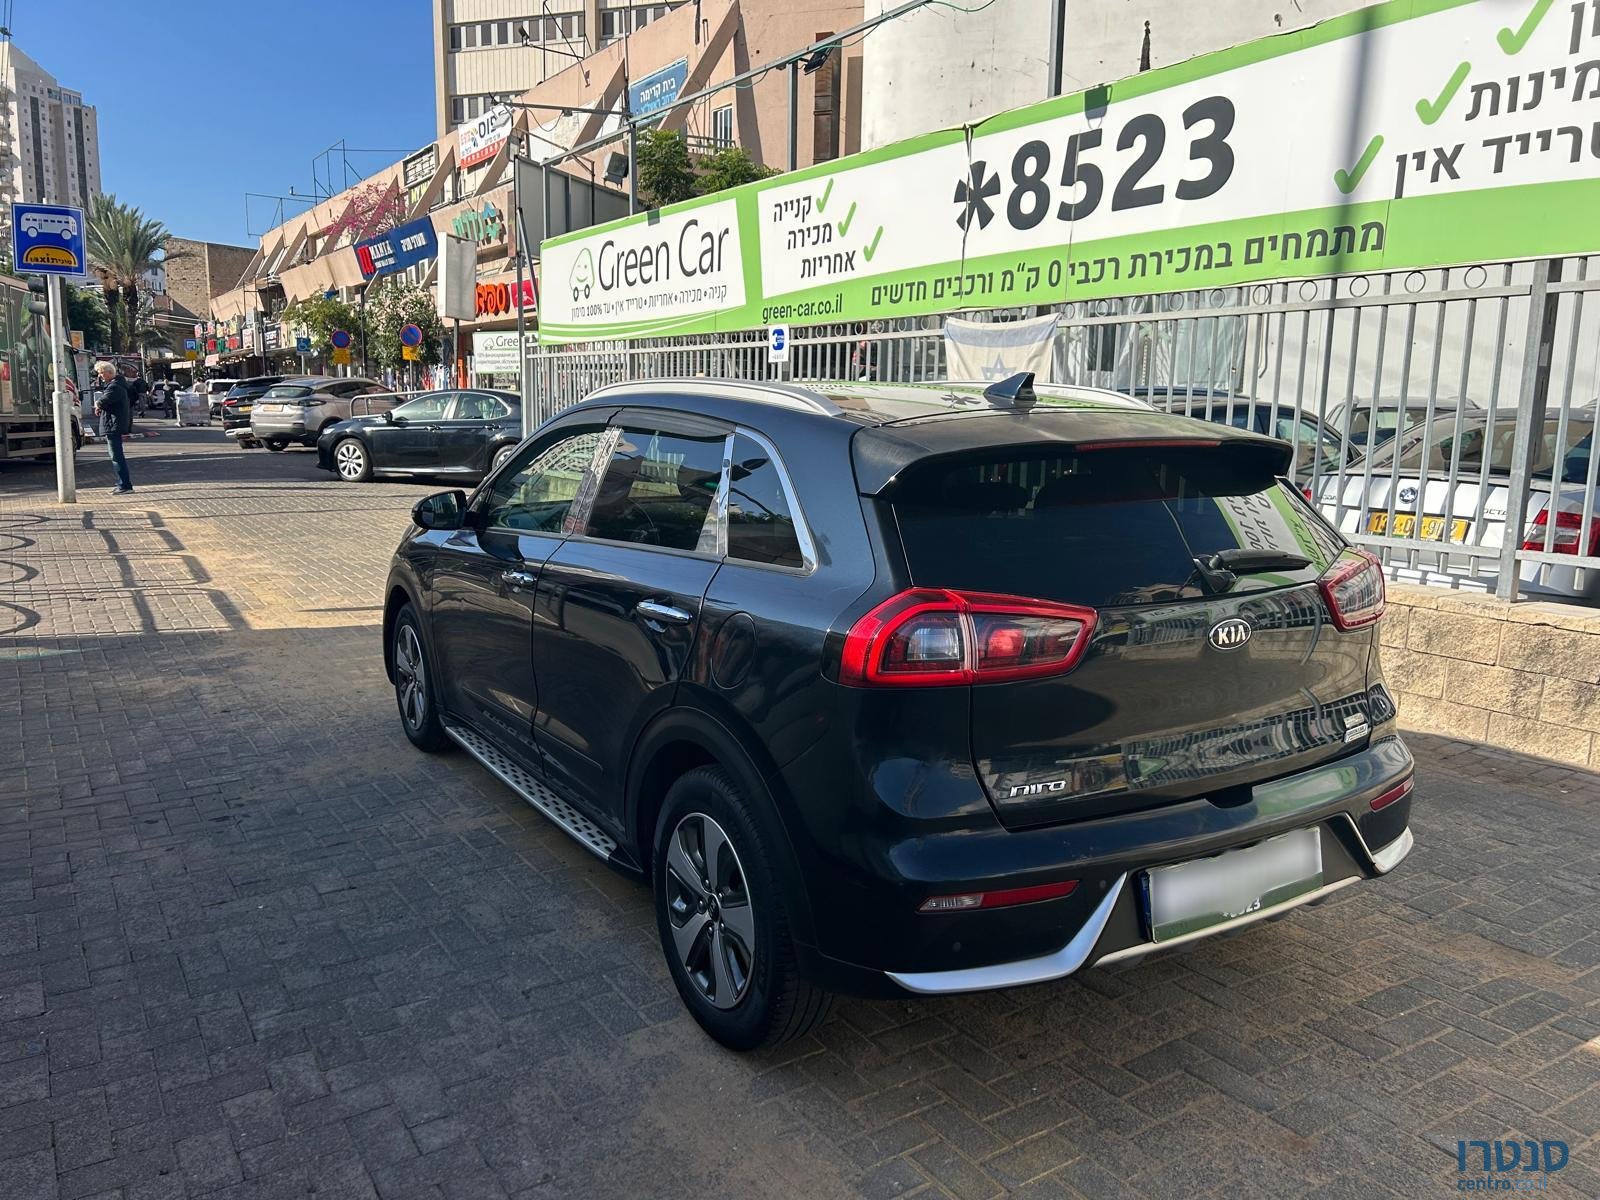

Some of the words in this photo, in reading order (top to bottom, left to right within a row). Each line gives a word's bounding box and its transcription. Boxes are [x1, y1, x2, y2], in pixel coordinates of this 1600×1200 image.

[662, 77, 676, 93] בית
[1394, 143, 1466, 200] אין
[773, 195, 812, 223] קנייה
[787, 222, 832, 250] מכירה
[1243, 220, 1385, 265] מתמחים
[598, 240, 670, 291] Green
[678, 218, 730, 277] Car
[800, 249, 856, 279] אחריות
[1128, 241, 1233, 279] במכירת
[933, 271, 994, 299] ורכבים
[1048, 259, 1062, 287] 0
[1068, 257, 1120, 285] רכבי
[678, 288, 702, 304] מכירה
[871, 280, 927, 306] חדשים
[586, 303, 603, 316] 100%
[762, 292, 843, 325] green-car.co.il
[1217, 624, 1246, 645] KIA
[1010, 780, 1067, 797] niro
